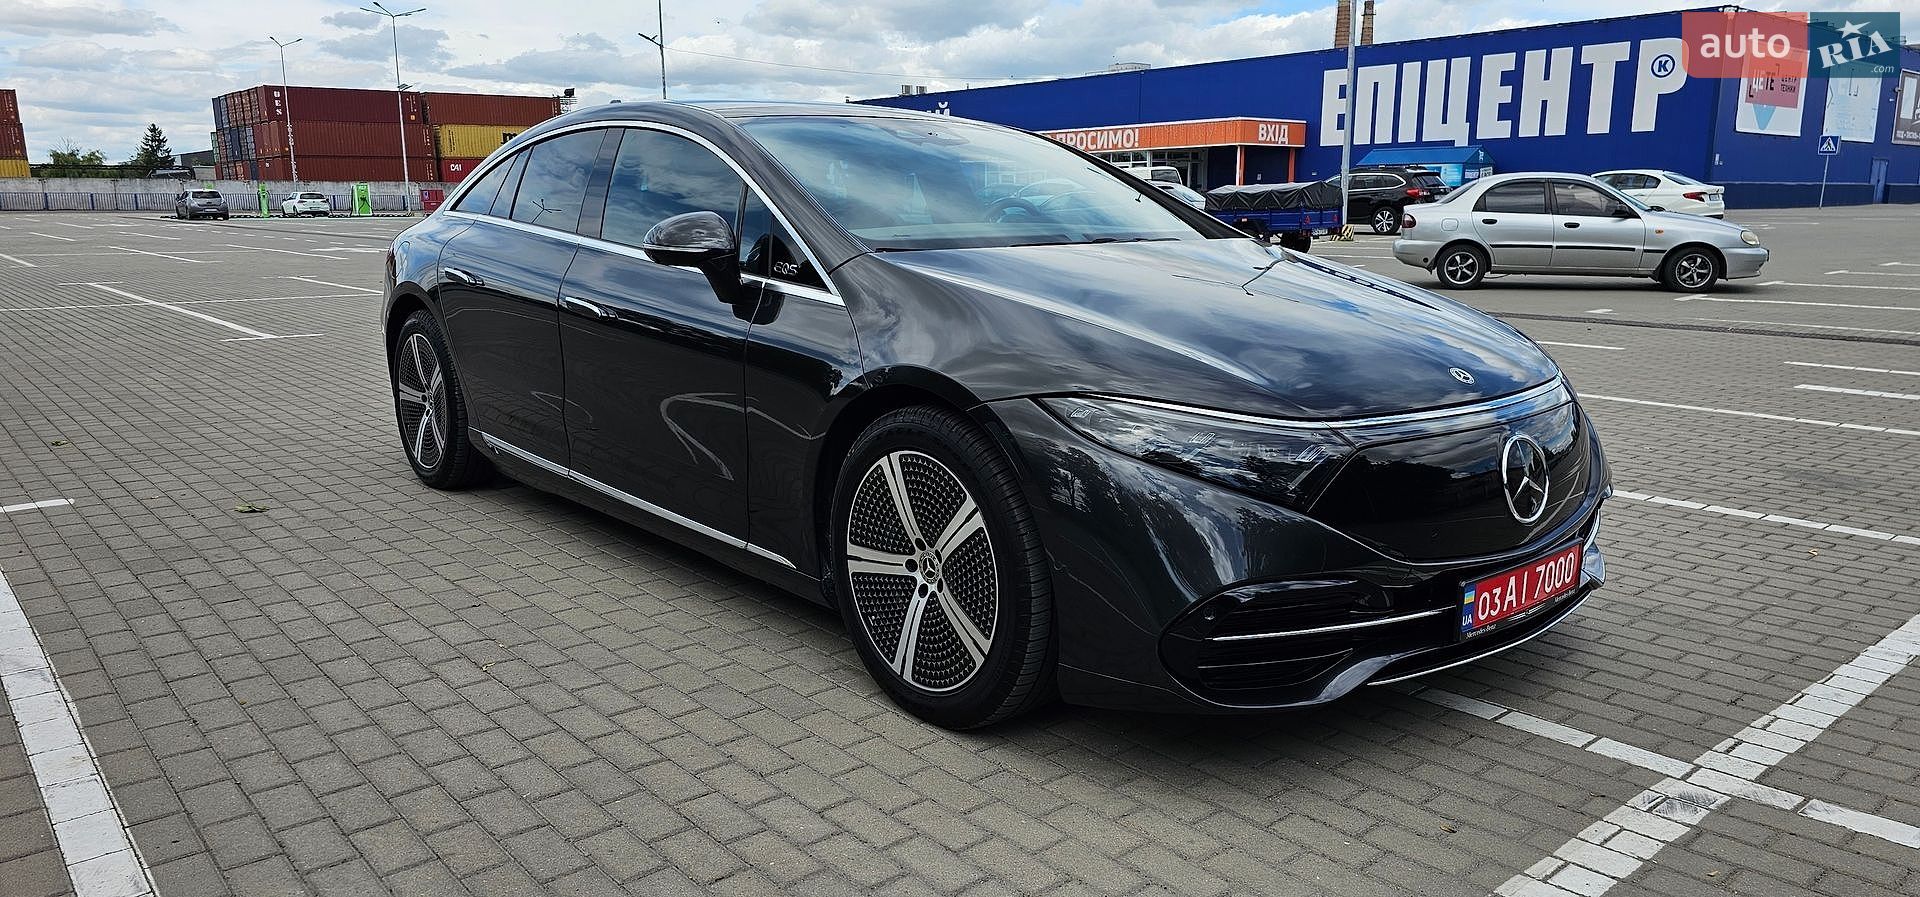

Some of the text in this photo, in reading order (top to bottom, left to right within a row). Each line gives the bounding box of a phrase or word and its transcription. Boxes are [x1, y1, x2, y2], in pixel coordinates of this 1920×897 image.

[1320, 38, 1689, 147] ЕПІЦЕНТР
[1258, 123, 1289, 145] ВХІД
[773, 261, 798, 276] EQS
[1478, 552, 1575, 621] 03AI 7000
[1462, 614, 1473, 627] UA
